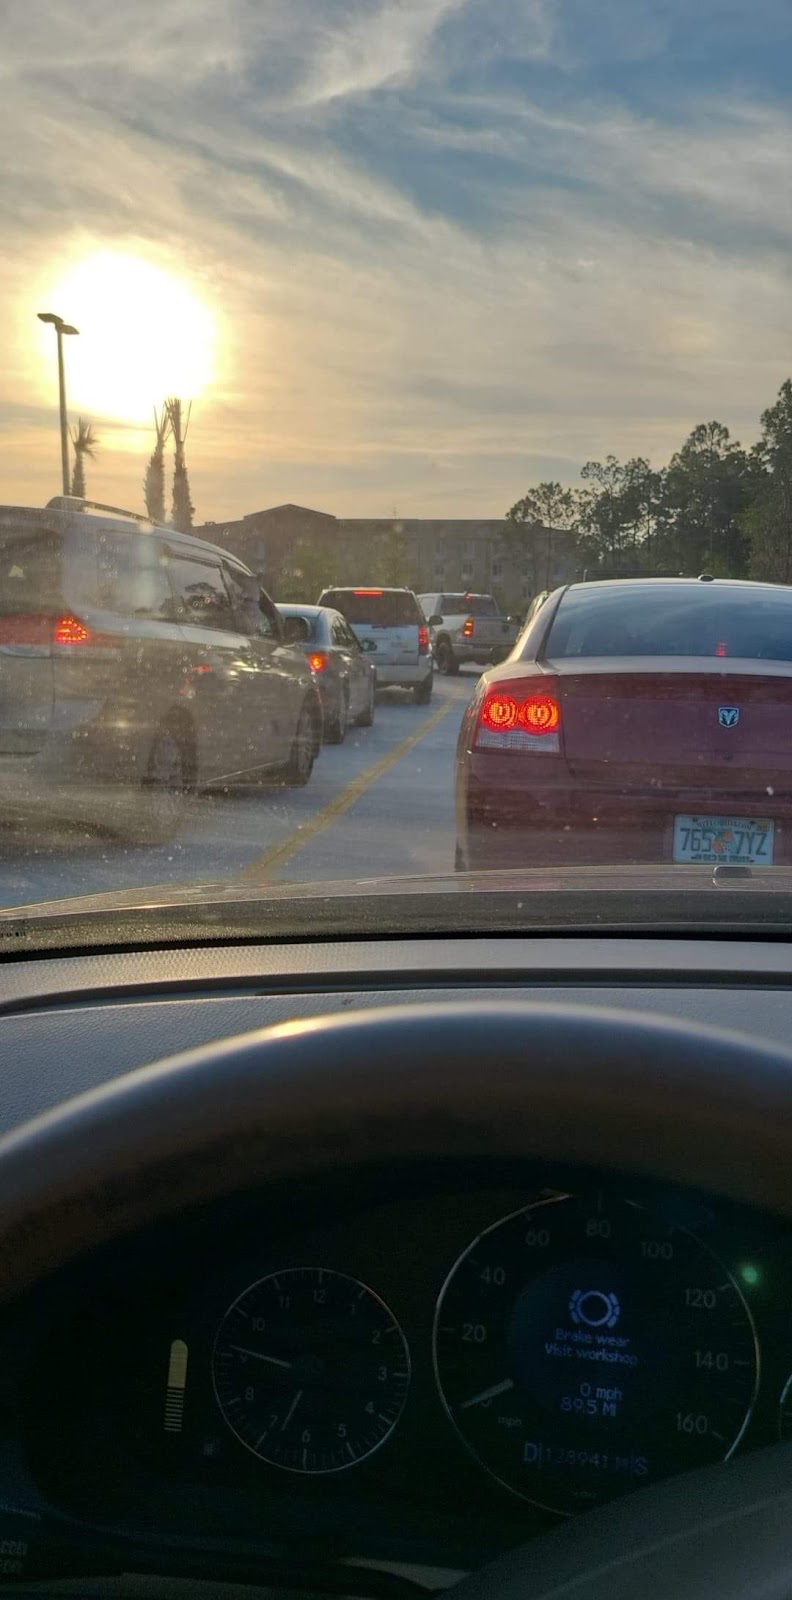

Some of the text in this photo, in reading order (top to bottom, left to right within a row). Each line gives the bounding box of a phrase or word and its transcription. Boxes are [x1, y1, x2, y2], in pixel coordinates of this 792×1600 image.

[679, 827, 767, 857] 765 7YZ
[524, 1228, 550, 1248] 60
[585, 1218, 611, 1238] 80
[640, 1240, 673, 1261] 100
[480, 1266, 506, 1286] 40
[279, 1295, 291, 1310] 11
[313, 1288, 327, 1305] 12
[683, 1288, 716, 1309] 120
[252, 1316, 266, 1333] 10
[461, 1324, 487, 1343] 20
[371, 1329, 382, 1345] 2
[555, 1327, 631, 1348] Brake wear
[544, 1341, 638, 1368] Visit workshop
[694, 1350, 728, 1371] 140
[378, 1365, 388, 1382] 3
[244, 1385, 255, 1402] 8
[579, 1382, 625, 1402] 0 mph
[364, 1400, 375, 1415] 4
[337, 1422, 347, 1439] 5
[675, 1414, 709, 1434] 160
[300, 1428, 312, 1444] 6
